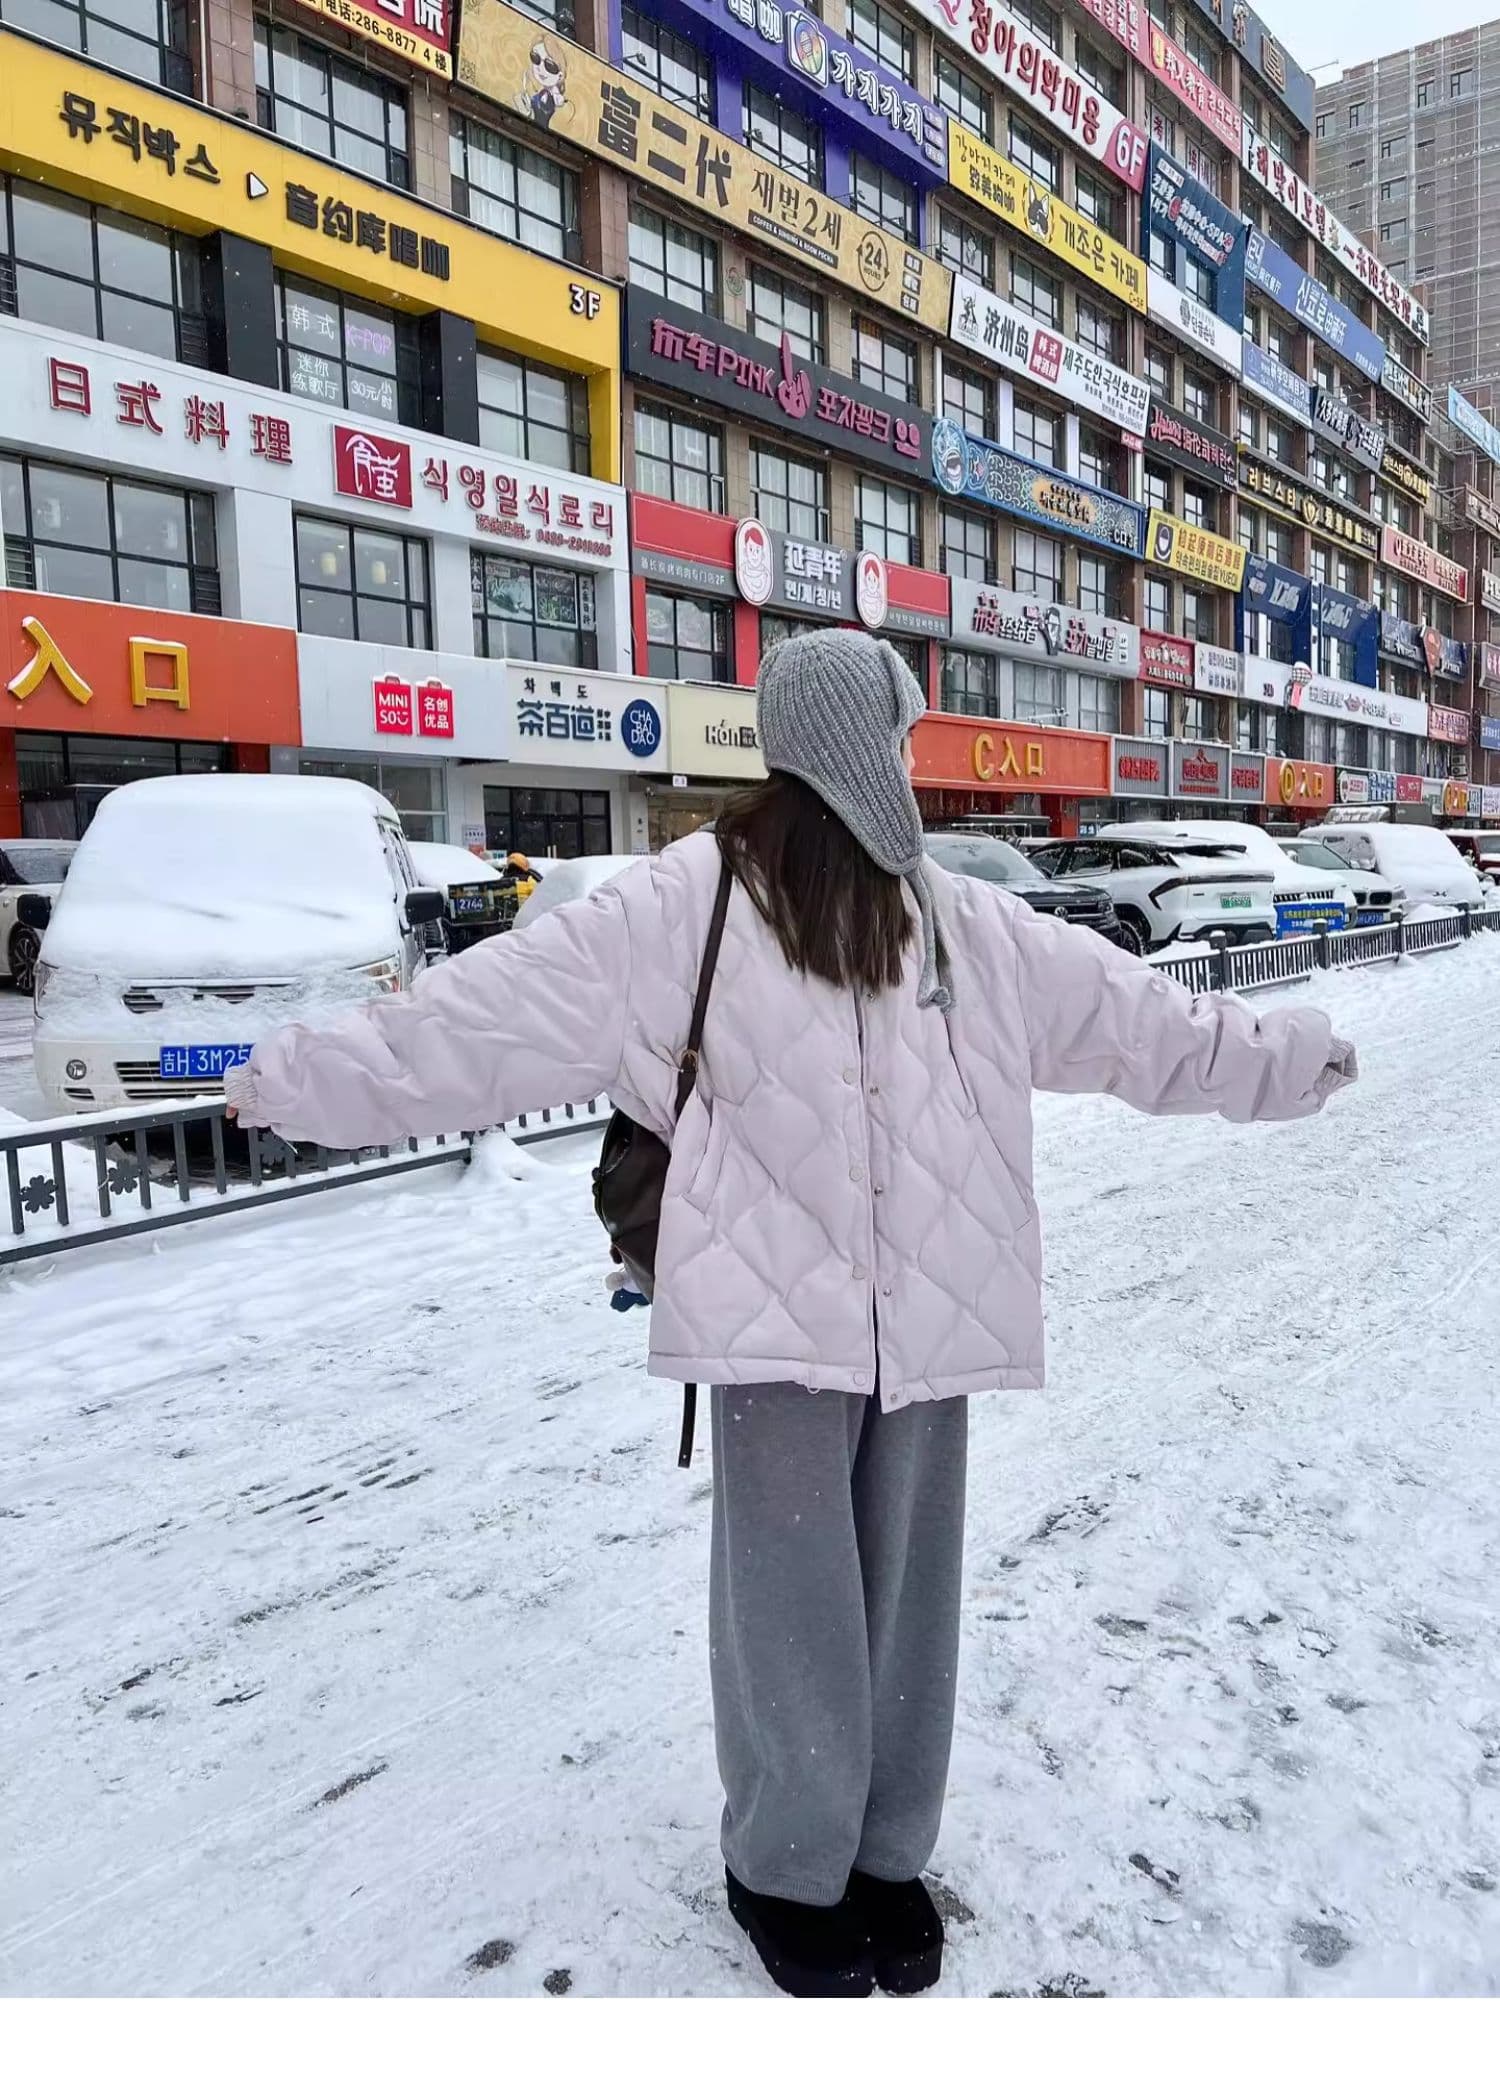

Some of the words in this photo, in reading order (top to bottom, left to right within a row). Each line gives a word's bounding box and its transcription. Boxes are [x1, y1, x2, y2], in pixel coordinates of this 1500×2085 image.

[831, 50, 923, 146] 가지가지
[60, 91, 220, 184] 뮤직박스
[598, 80, 732, 208] 富二代
[955, 134, 991, 173] 강아지
[1116, 127, 1146, 176] 6F
[750, 168, 842, 250] 재벌2세
[285, 181, 450, 281] 音约库唱咖
[864, 242, 882, 270] 24
[1059, 214, 1106, 273] 개조은
[1111, 252, 1139, 294] 카페
[569, 283, 600, 320] 3F
[290, 304, 335, 341] 韩式
[346, 326, 392, 356] K-POP
[982, 306, 1029, 365] 济州岛
[297, 351, 329, 377] 迷你
[652, 317, 775, 398] 布车PINK
[815, 386, 890, 443] 포차핑크
[291, 371, 339, 399] 练歌厅
[47, 356, 294, 466] 日式料理
[420, 457, 614, 540] 식영일식료리
[7, 615, 191, 711] 入口
[379, 692, 408, 708] MINI
[424, 696, 448, 712] 名创
[523, 677, 589, 698] 차백도
[425, 713, 449, 729] 优品
[517, 698, 596, 741] 茶百道
[630, 710, 652, 723] CHA
[637, 721, 652, 733] BAI
[631, 729, 655, 746] DAO
[974, 732, 1044, 780] C入口
[163, 1049, 249, 1075] 吉H·3M25
